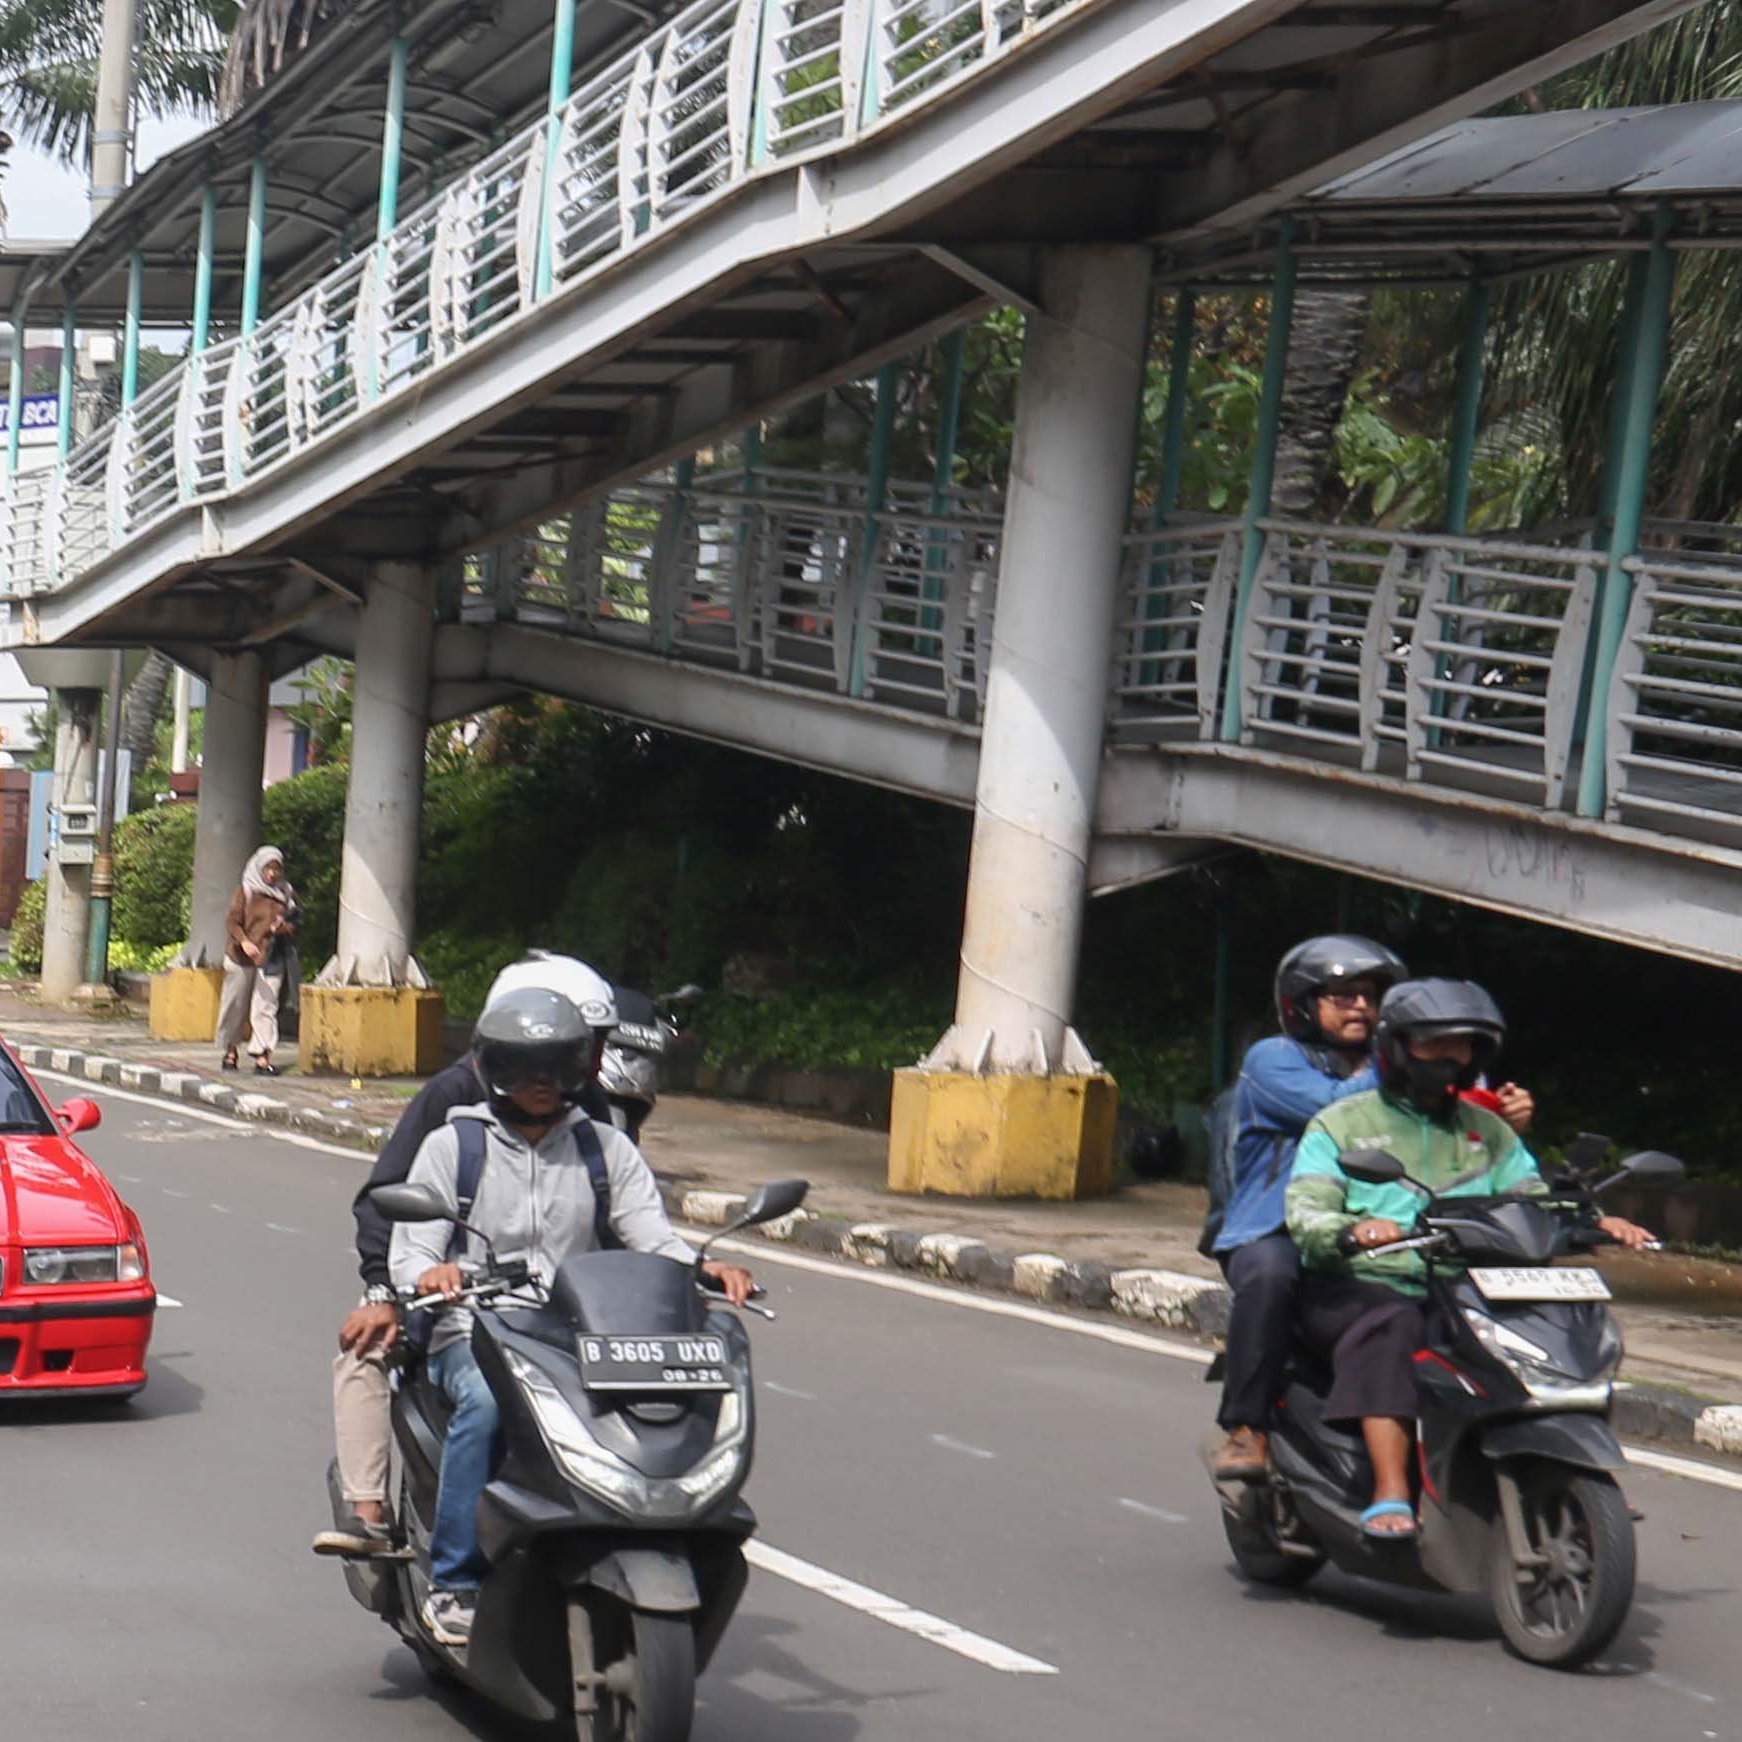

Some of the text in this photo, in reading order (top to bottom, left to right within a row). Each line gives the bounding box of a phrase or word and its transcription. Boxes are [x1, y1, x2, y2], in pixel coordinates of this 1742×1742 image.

[21, 400, 58, 426] BCA
[586, 1341, 722, 1363] B 3605 UXD
